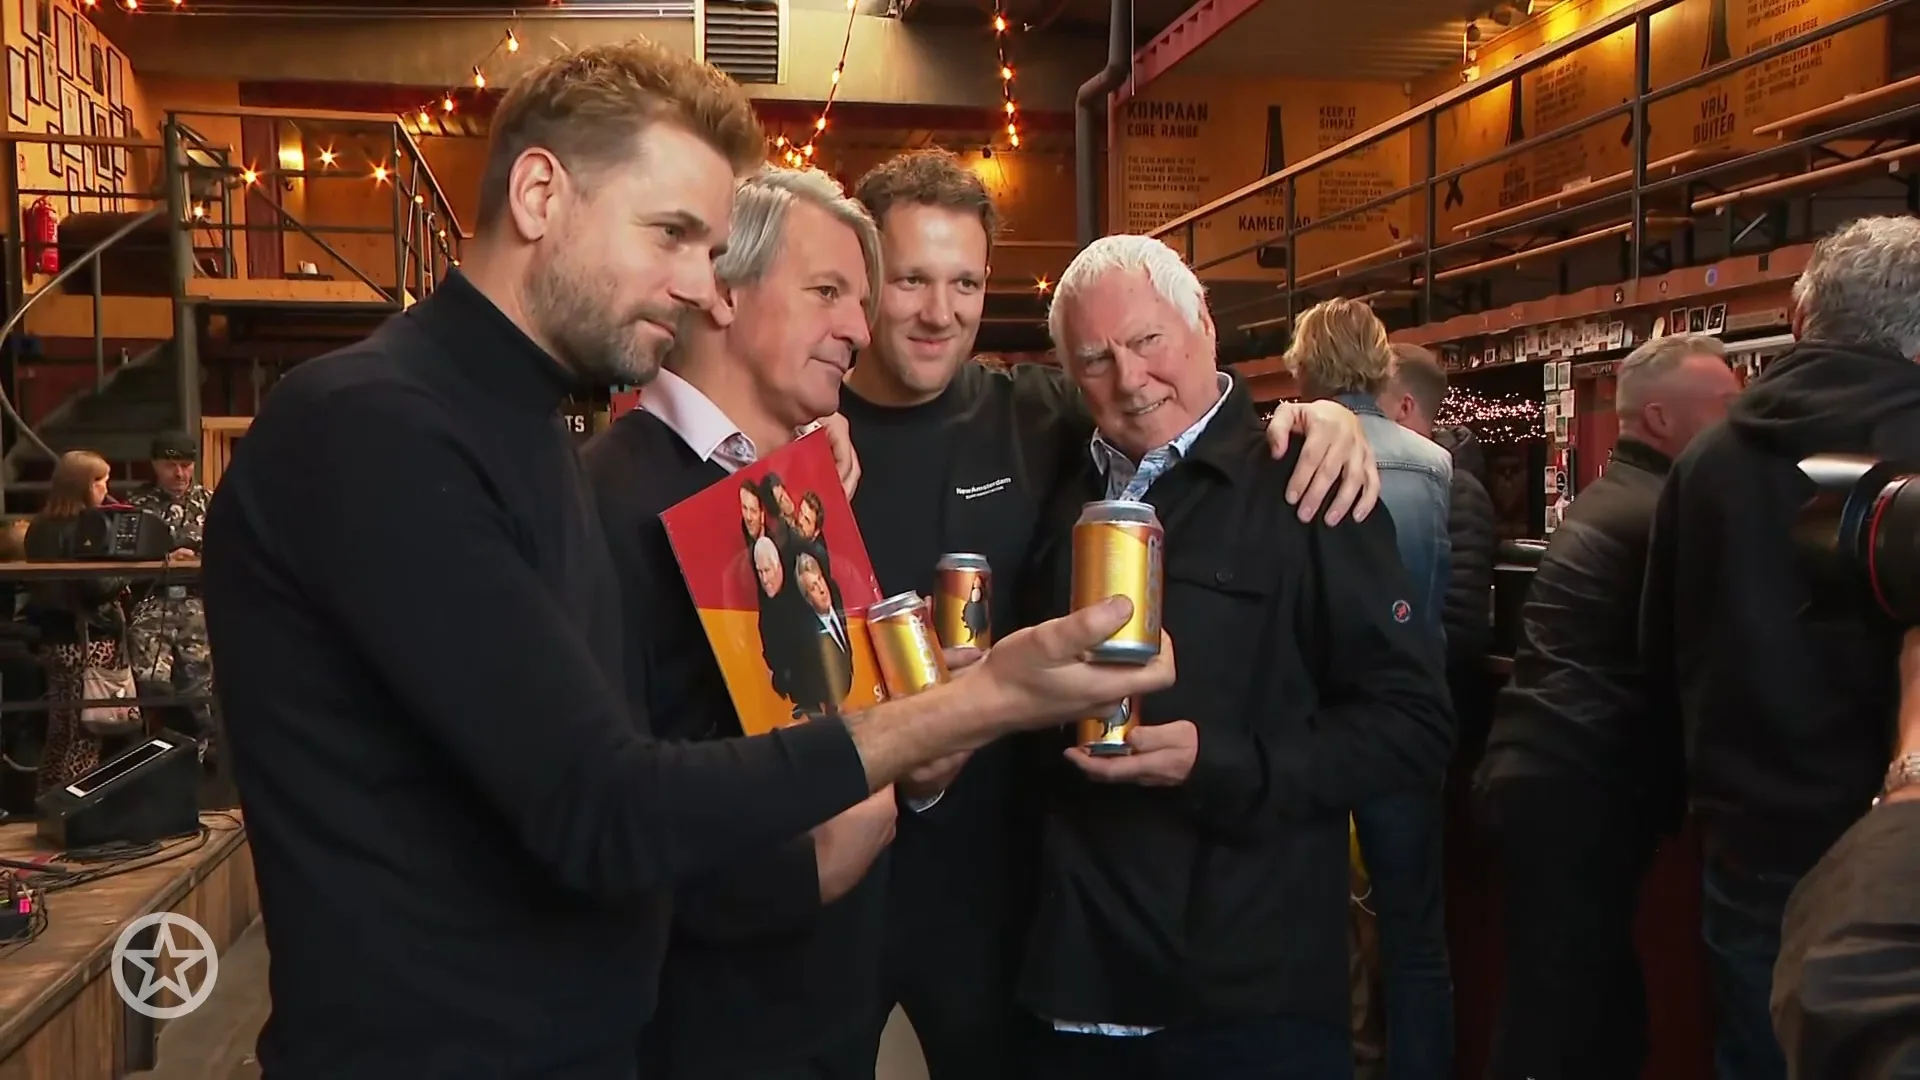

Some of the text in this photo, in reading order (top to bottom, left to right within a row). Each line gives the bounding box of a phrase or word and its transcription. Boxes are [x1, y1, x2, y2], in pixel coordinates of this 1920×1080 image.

[1127, 100, 1208, 121] KOMPAAN
[1319, 105, 1356, 118] KEEP IT
[1701, 92, 1728, 119] VRIJ
[1127, 123, 1199, 139] CORE RANGE
[1319, 118, 1355, 129] SIMPLE
[1693, 112, 1735, 145] BUITER
[1238, 215, 1312, 231] KAMERAD
[955, 477, 1012, 495] NewAmsterdam
